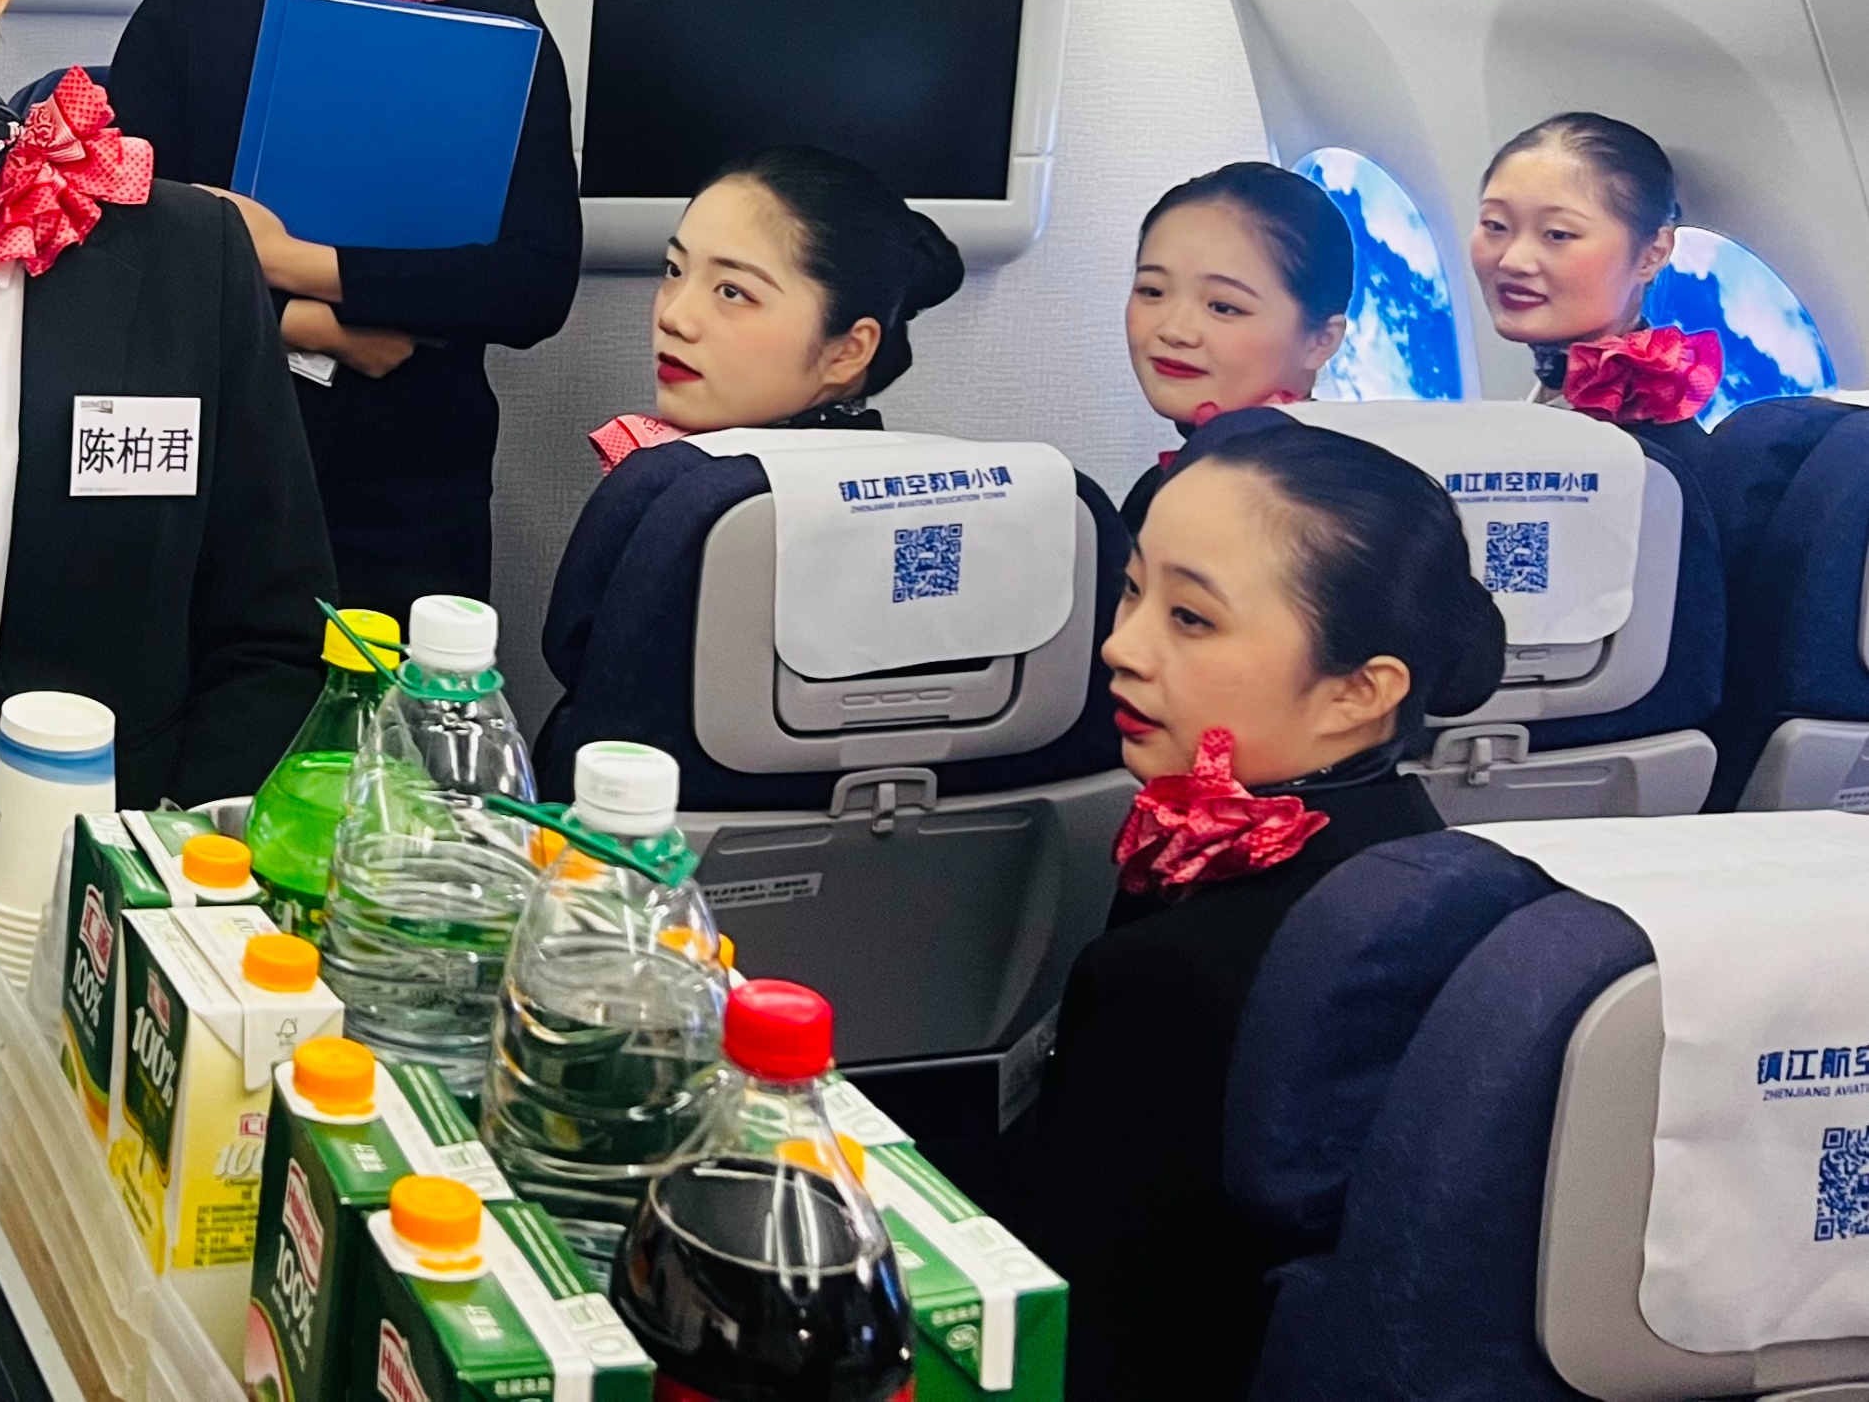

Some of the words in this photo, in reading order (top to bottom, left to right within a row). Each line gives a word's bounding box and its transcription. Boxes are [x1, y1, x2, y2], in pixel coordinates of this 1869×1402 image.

[77, 426, 194, 475] 陈柏君
[838, 465, 1014, 503] 镇江航空教育小镇
[72, 948, 104, 1028] 100%
[131, 1005, 177, 1109] 100%
[276, 1232, 315, 1348] 100%
